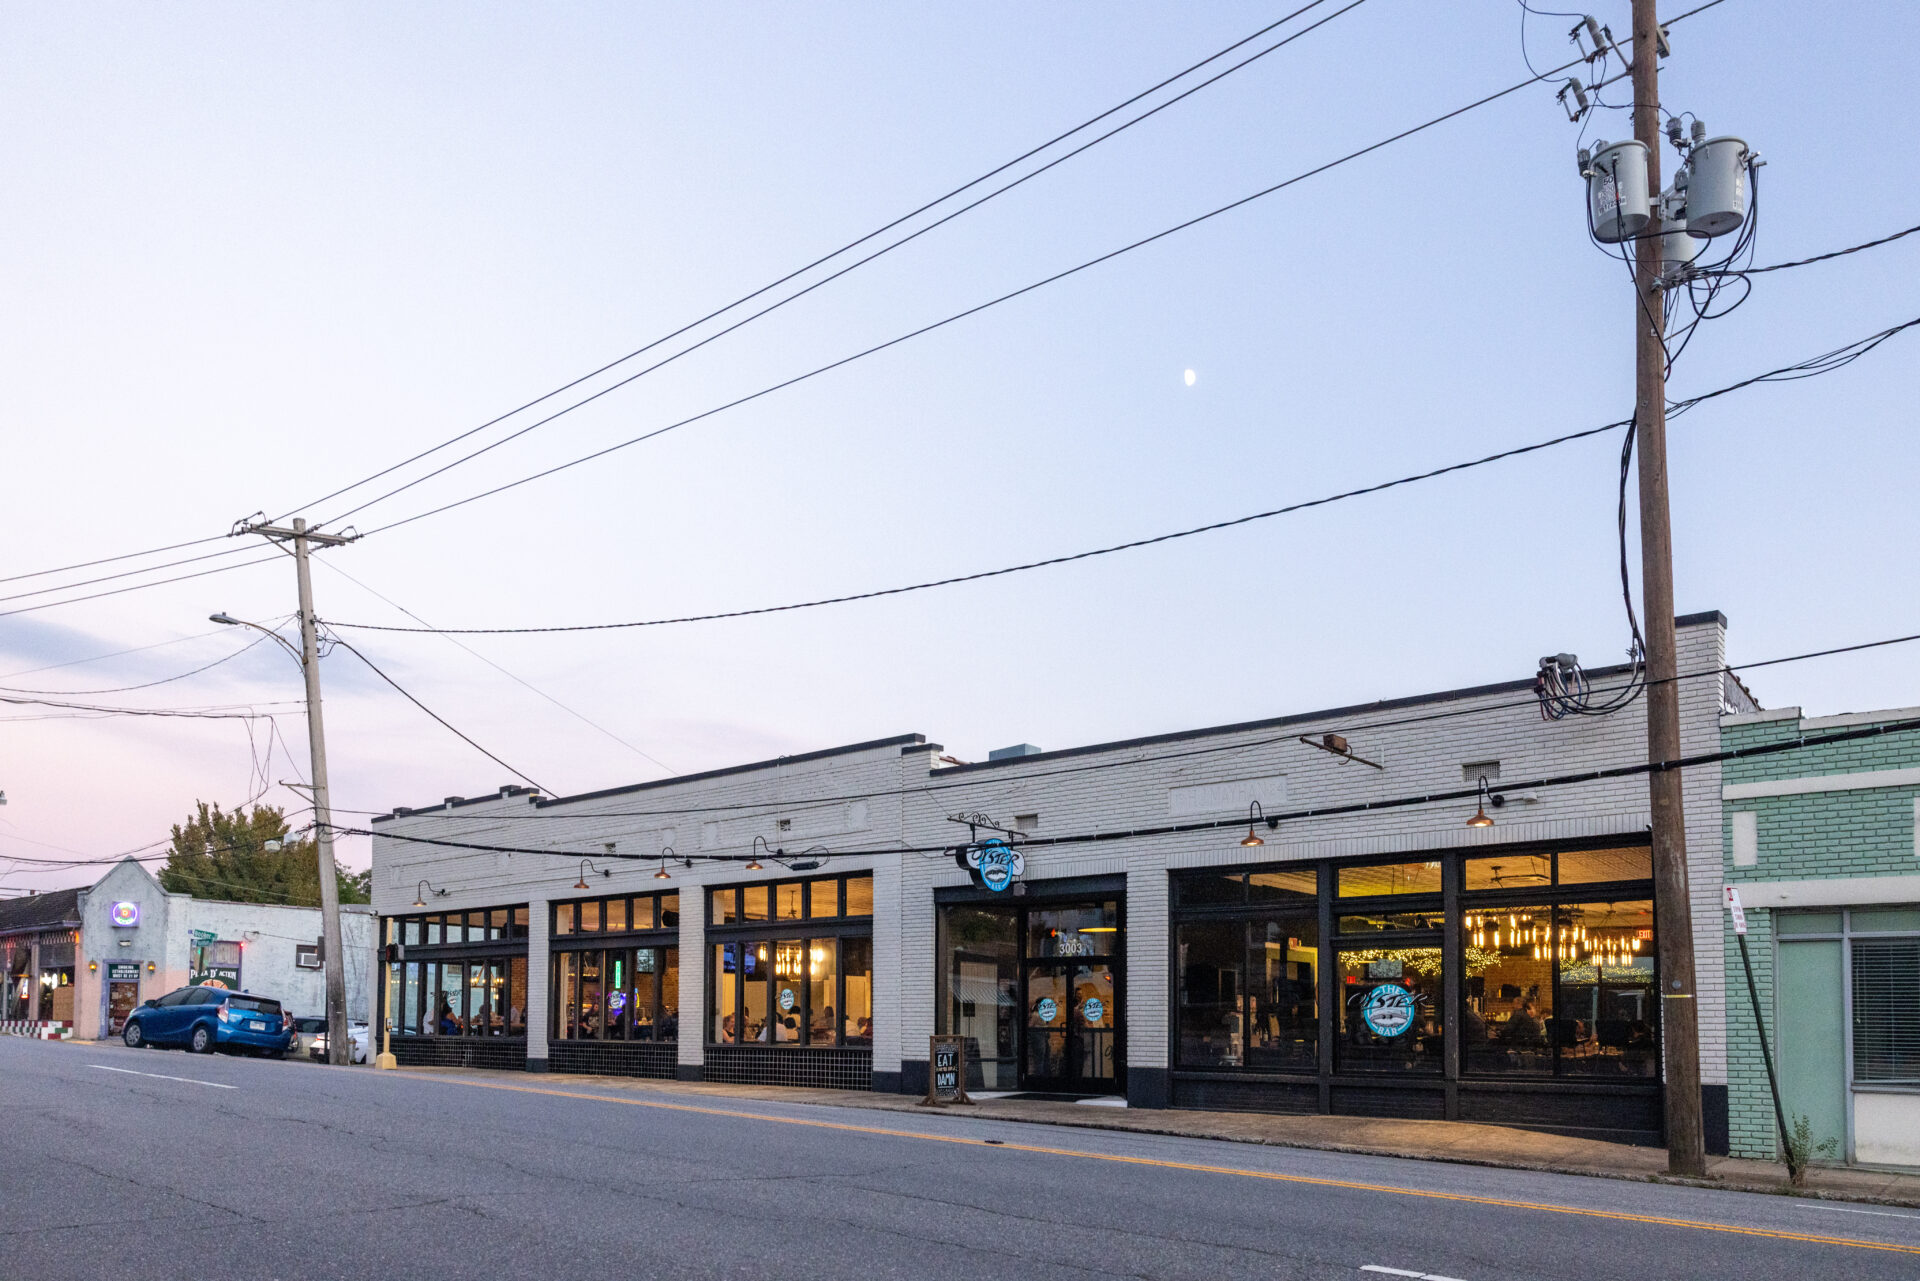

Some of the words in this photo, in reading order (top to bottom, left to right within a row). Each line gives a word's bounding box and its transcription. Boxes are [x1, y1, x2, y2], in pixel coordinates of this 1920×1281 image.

[971, 848, 1020, 869] OYSTER
[1060, 943, 1083, 954] 3003
[190, 970, 208, 979] PIZA
[1380, 985, 1401, 995] THE
[1377, 1026, 1398, 1037] BAR
[937, 1053, 954, 1067] EAT
[937, 1072, 956, 1086] DAMN
